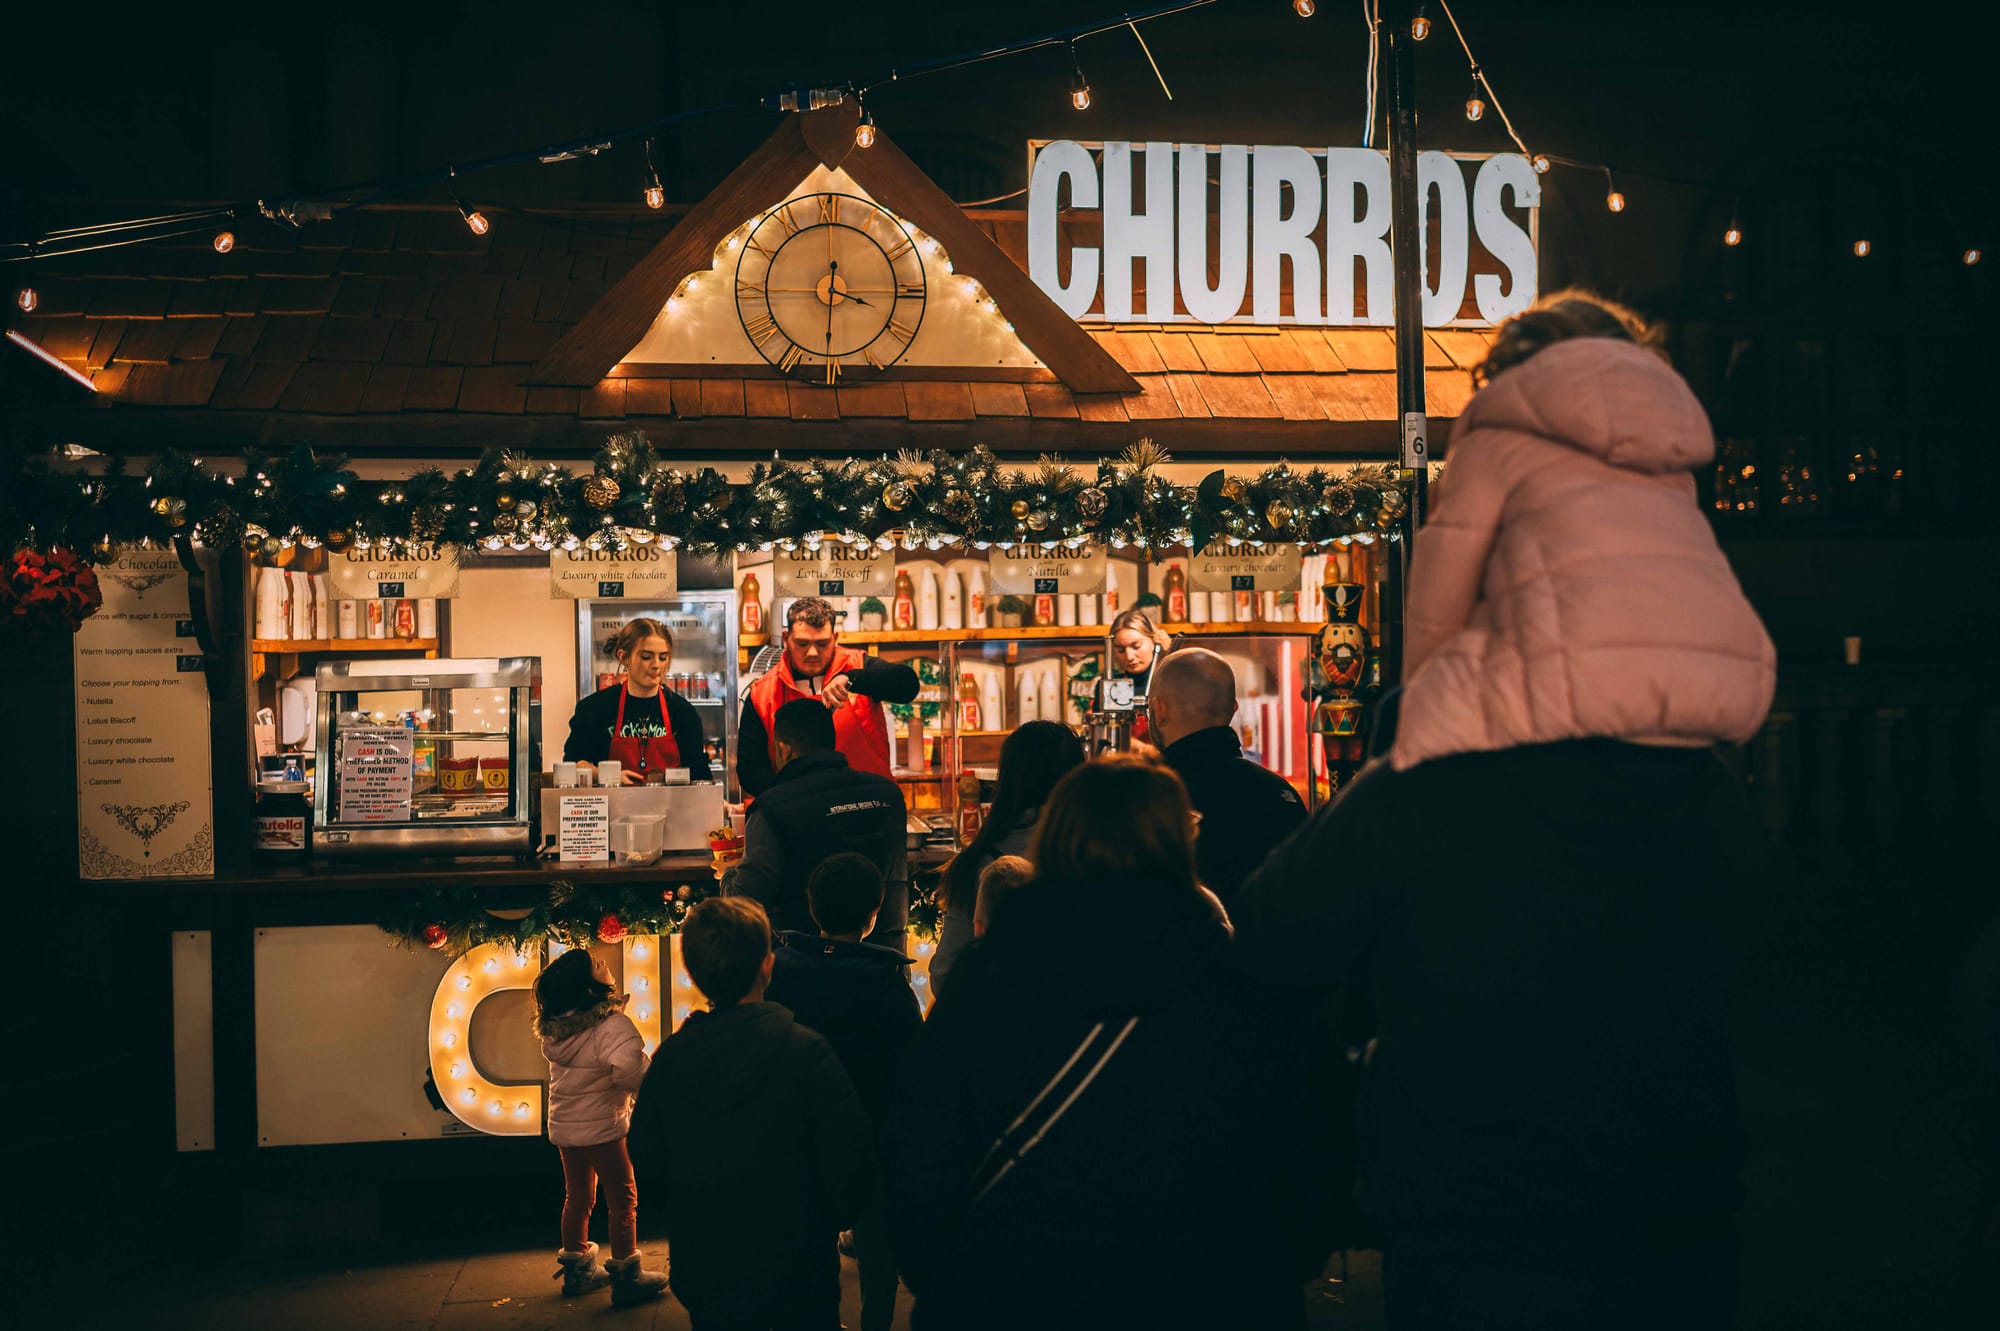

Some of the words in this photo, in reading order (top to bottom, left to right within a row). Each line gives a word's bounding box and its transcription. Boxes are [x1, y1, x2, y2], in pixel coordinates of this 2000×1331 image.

[1027, 140, 1541, 328] CHURROS
[1413, 436, 1424, 454] 6
[118, 556, 178, 570] Chocolate
[367, 566, 421, 580] Caramel
[561, 570, 598, 584] Luxury
[600, 569, 624, 580] white
[627, 568, 667, 580] chocolate
[796, 567, 828, 579] Lotus
[831, 565, 873, 583] Biscoff
[1027, 563, 1069, 577] Nutella
[382, 583, 400, 595] £7
[602, 583, 620, 595] £7
[823, 582, 840, 593] £7
[1037, 580, 1056, 592] £7
[105, 648, 133, 656] topping
[131, 679, 160, 687] topping
[87, 738, 113, 746] Luxury
[383, 757, 409, 765] METHOD
[88, 777, 122, 786] Caramel
[256, 818, 303, 830] nutella
